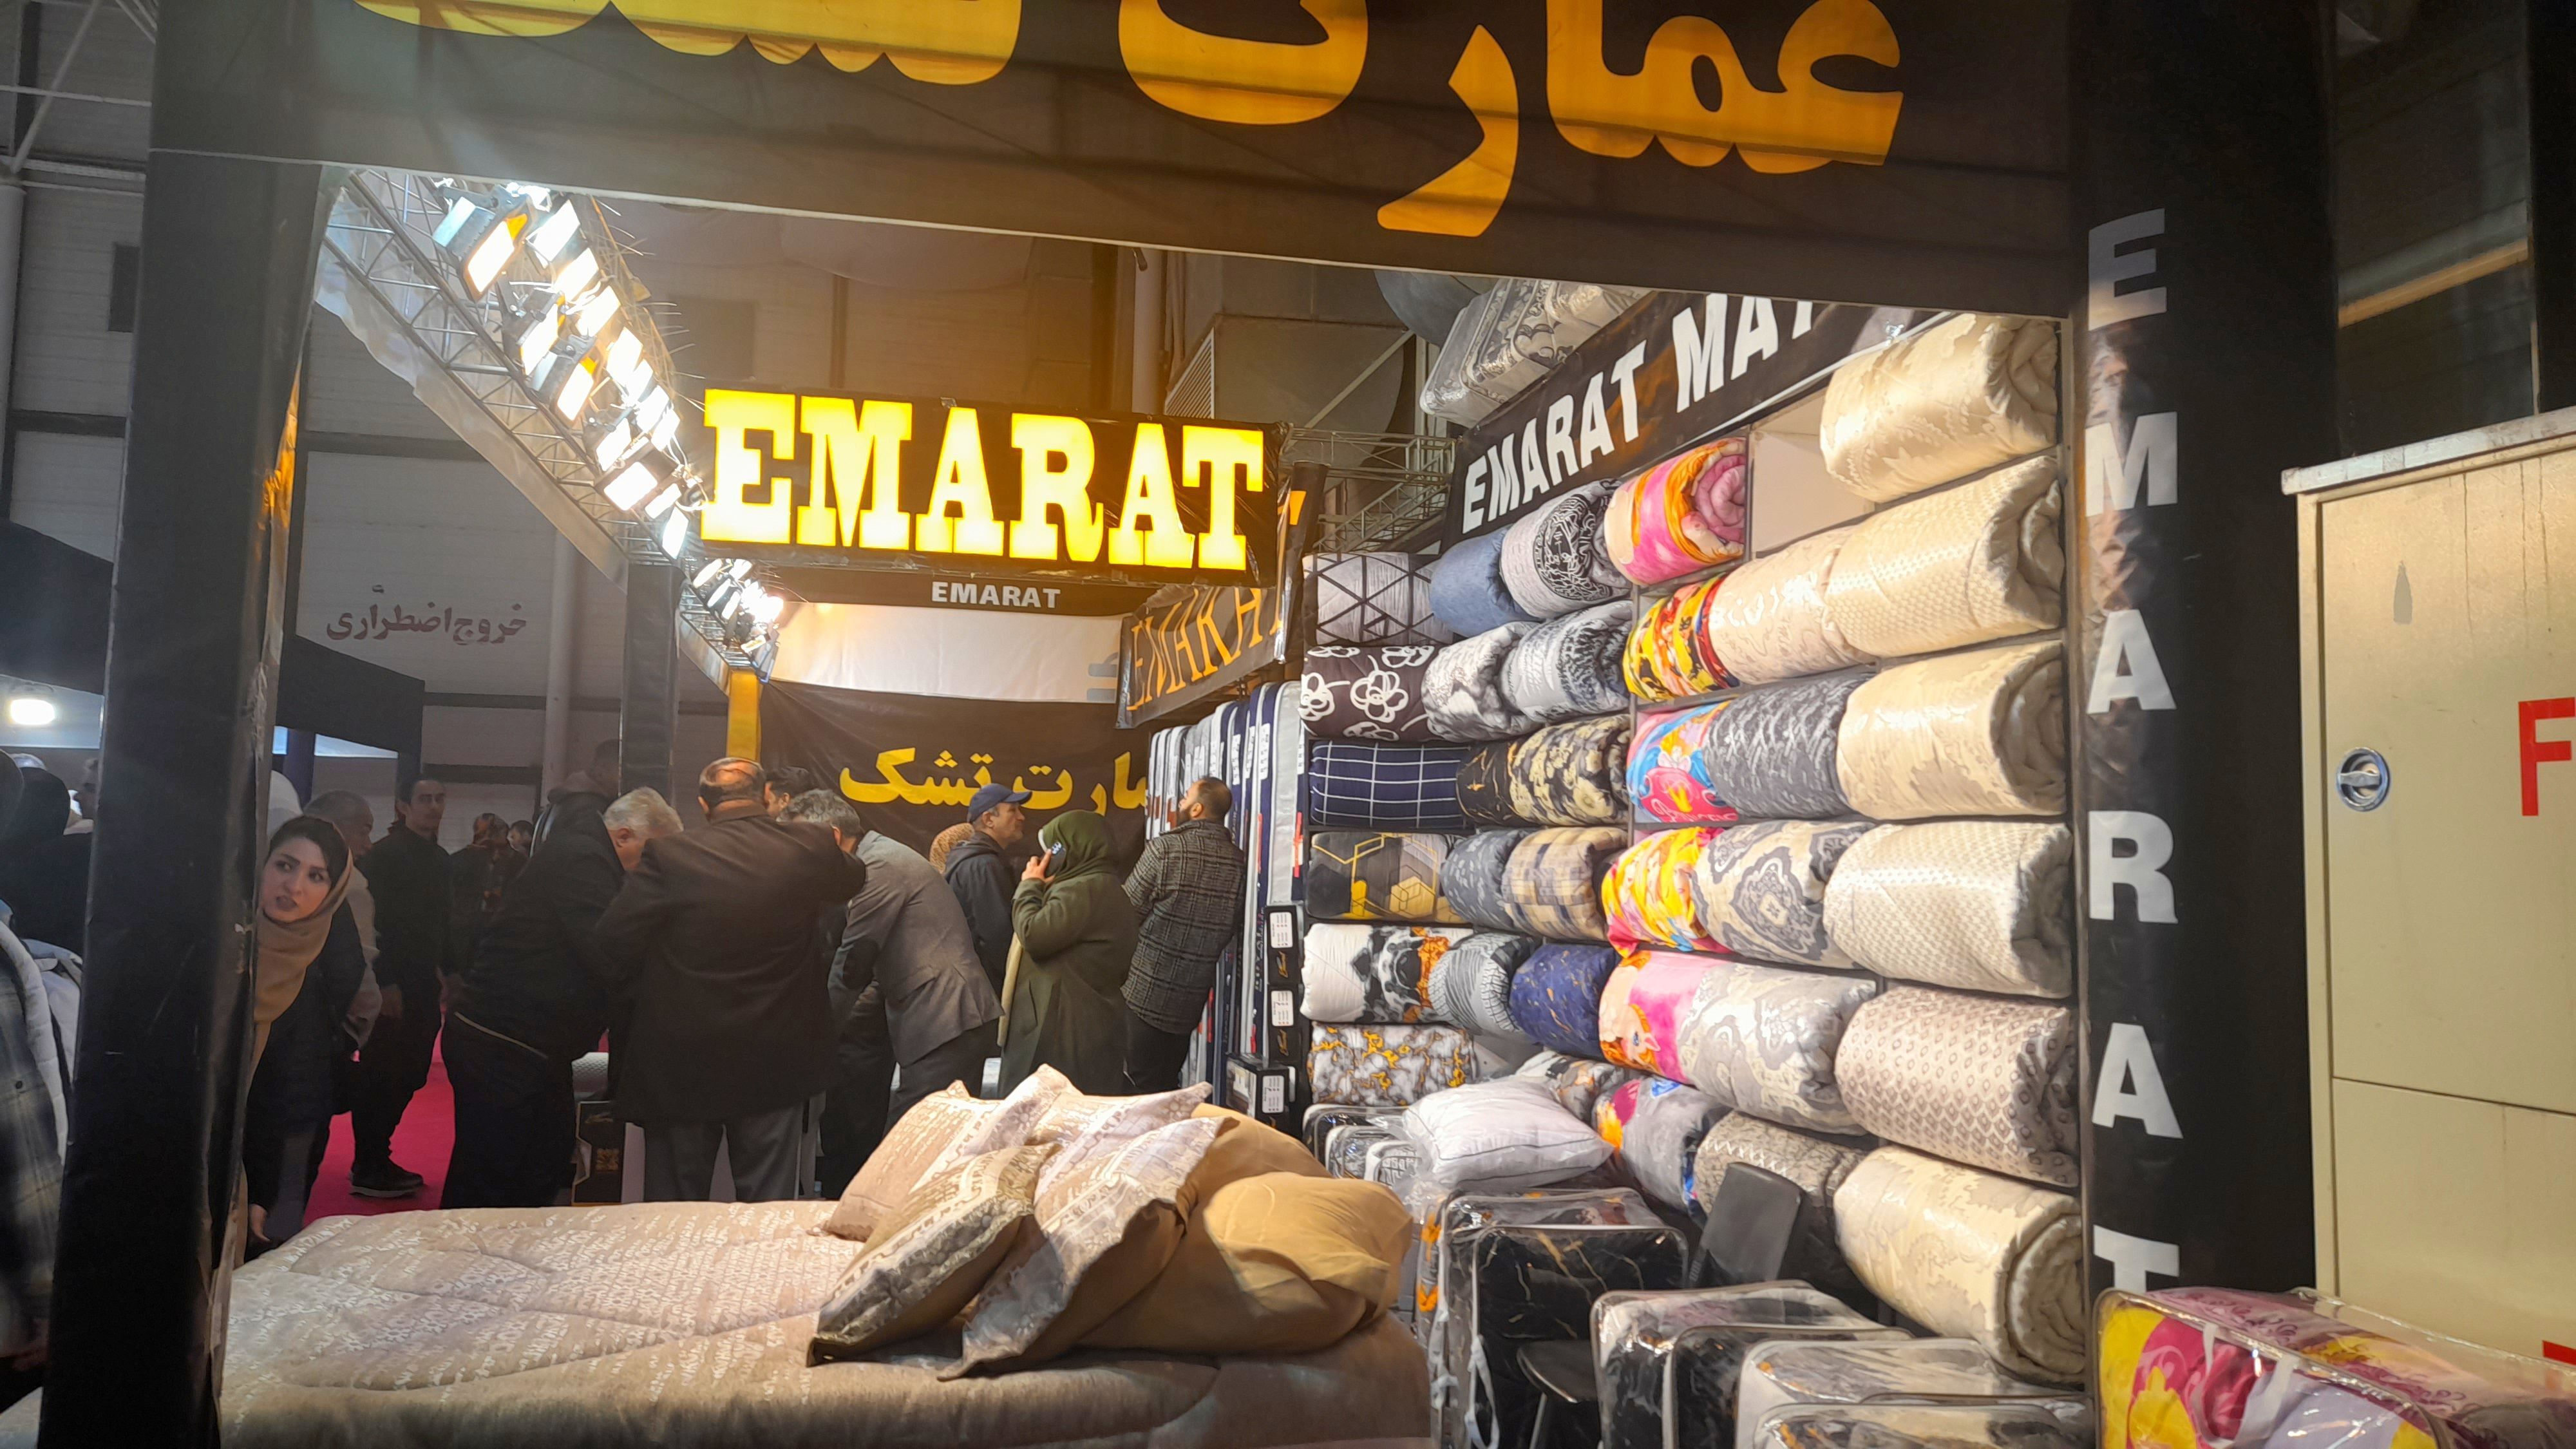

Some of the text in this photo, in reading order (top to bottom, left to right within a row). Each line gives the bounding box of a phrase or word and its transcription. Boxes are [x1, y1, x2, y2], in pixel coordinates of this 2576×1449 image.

[701, 388, 1264, 571] EMARAT
[1462, 340, 1648, 535] EMARAT
[327, 601, 527, 645] خروج اضطراری
[931, 582, 1062, 609] EMARAT
[839, 748, 994, 807] تشک
[2085, 208, 2184, 1293] EMARAT
